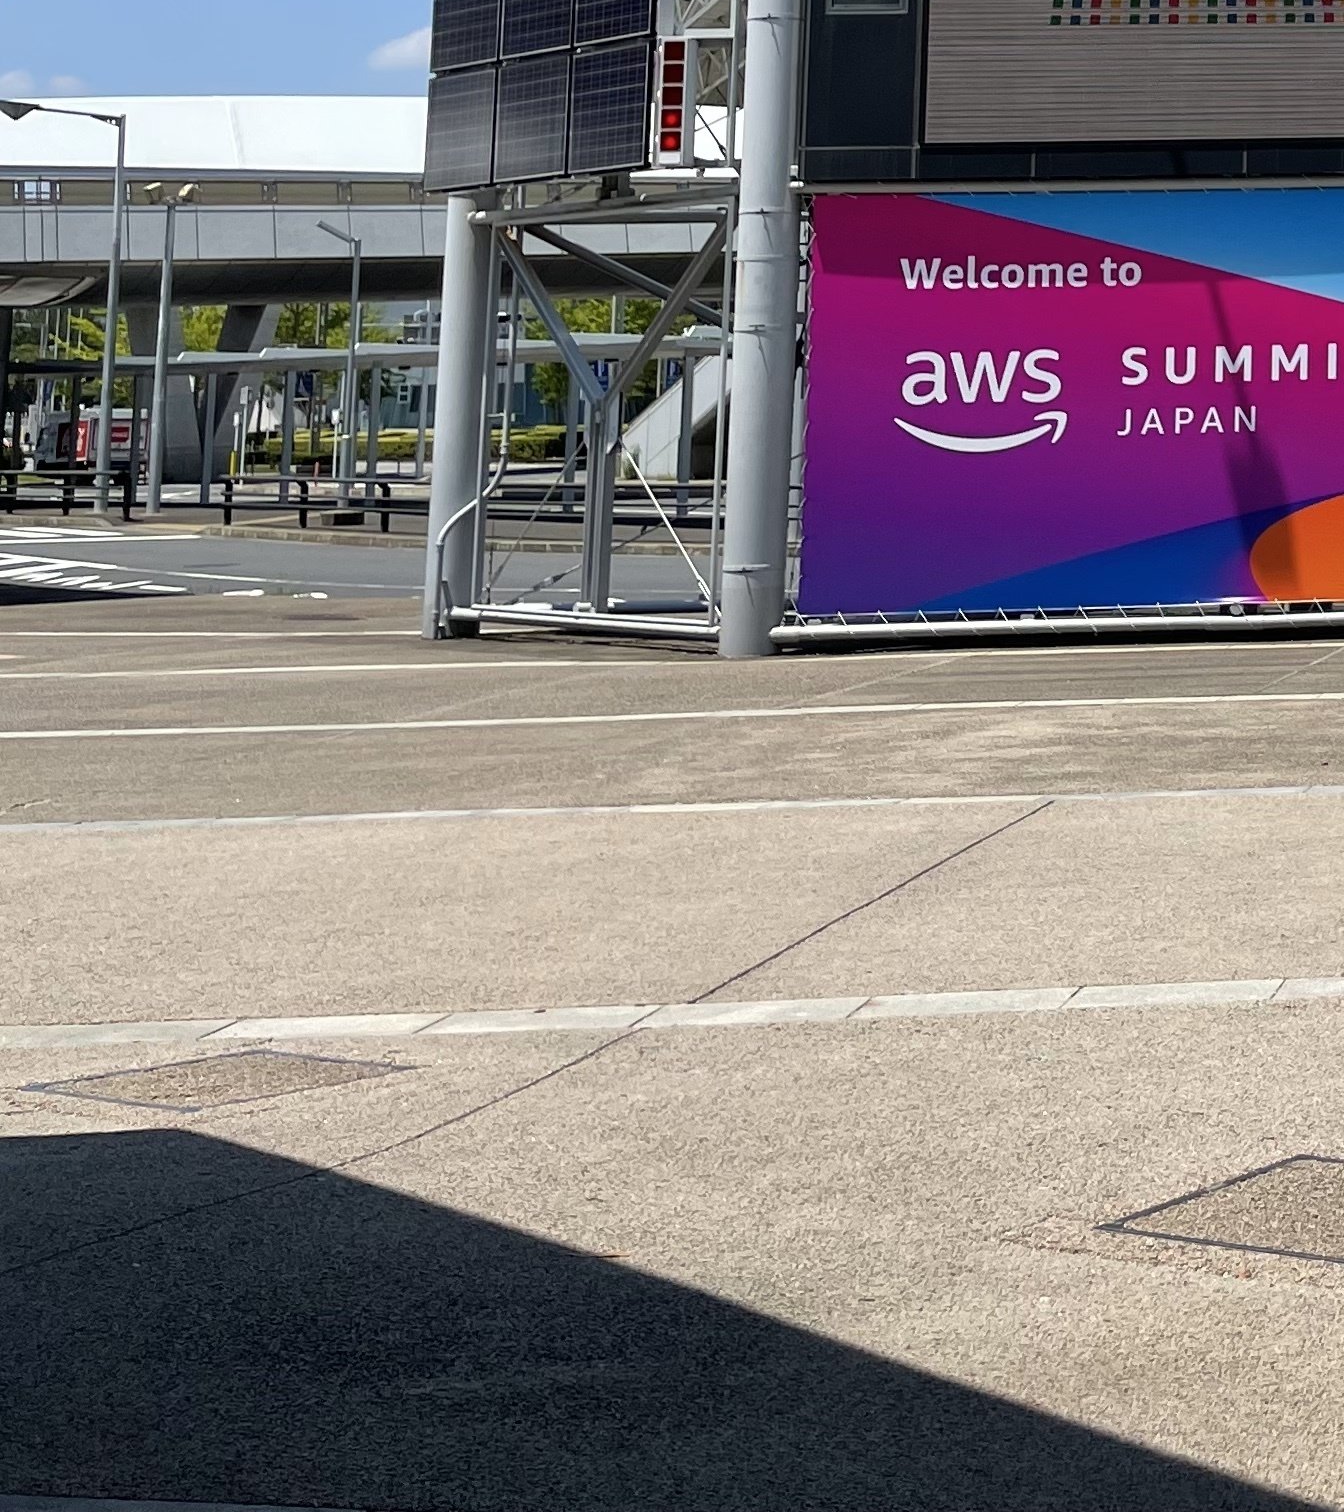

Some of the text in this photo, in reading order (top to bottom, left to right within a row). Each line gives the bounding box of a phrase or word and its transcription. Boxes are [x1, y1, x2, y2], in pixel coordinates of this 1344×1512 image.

[900, 255, 1142, 290] Welcome to
[901, 348, 1062, 406] aws
[1117, 405, 1258, 437] JAPAN
